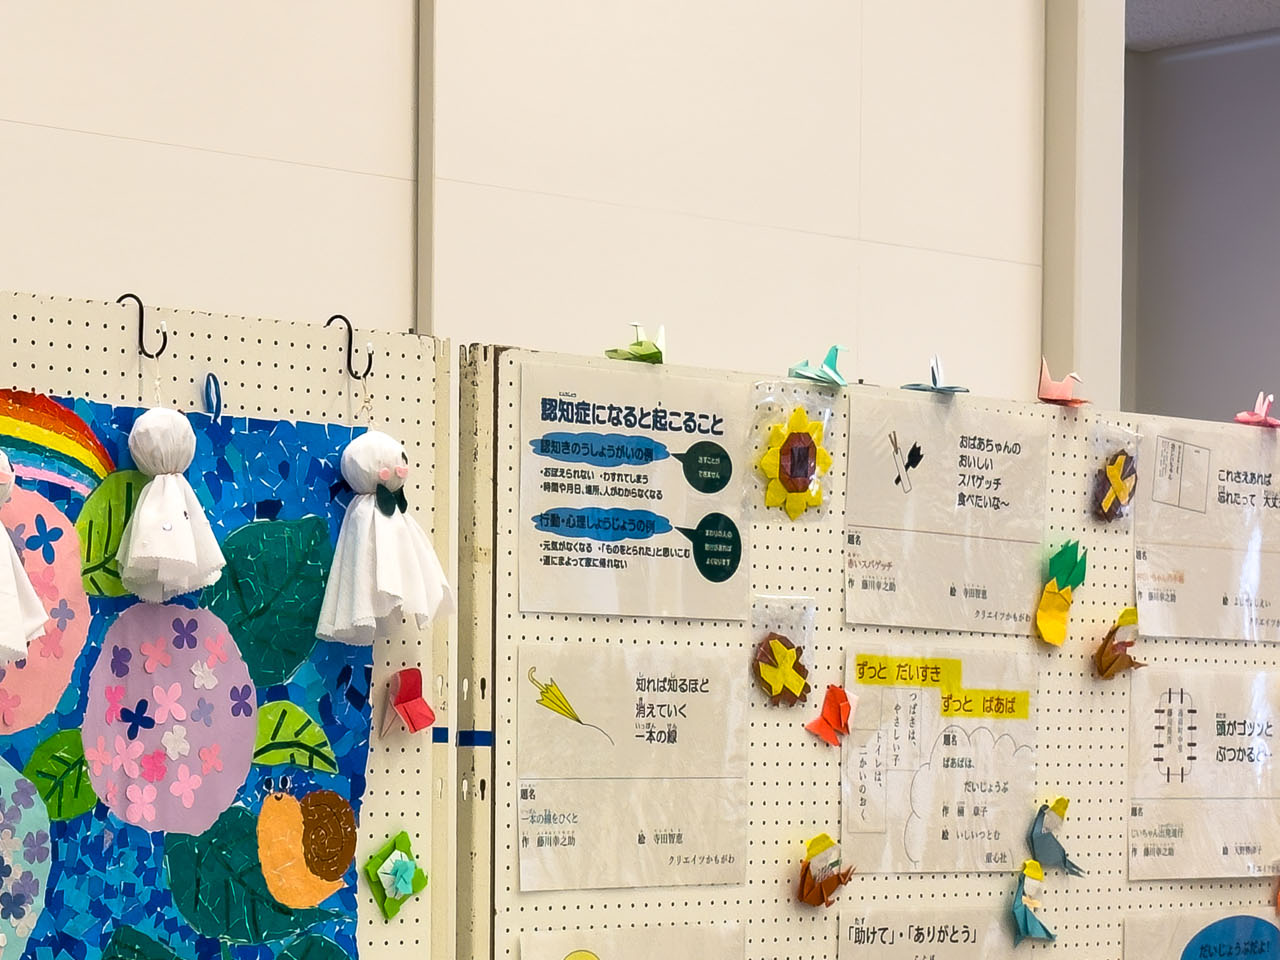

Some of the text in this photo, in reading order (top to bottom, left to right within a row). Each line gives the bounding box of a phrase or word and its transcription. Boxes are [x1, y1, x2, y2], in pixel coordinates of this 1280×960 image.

[540, 397, 725, 436] 認知症になると起こること
[959, 434, 1022, 456] おばあちゃんの
[958, 453, 994, 471] おいしい
[1218, 469, 1273, 487] これさえあれば
[1262, 492, 1280, 509] 大丈
[856, 661, 942, 684] ずっと だいすき
[635, 676, 710, 695] 知れば知るほど
[634, 702, 688, 720] 消えていく
[941, 694, 1017, 714] ずっと ばあば
[635, 729, 679, 745] 一本の線
[520, 788, 536, 801] 題名
[847, 924, 978, 946] 「助けて」・「ありがとう」
